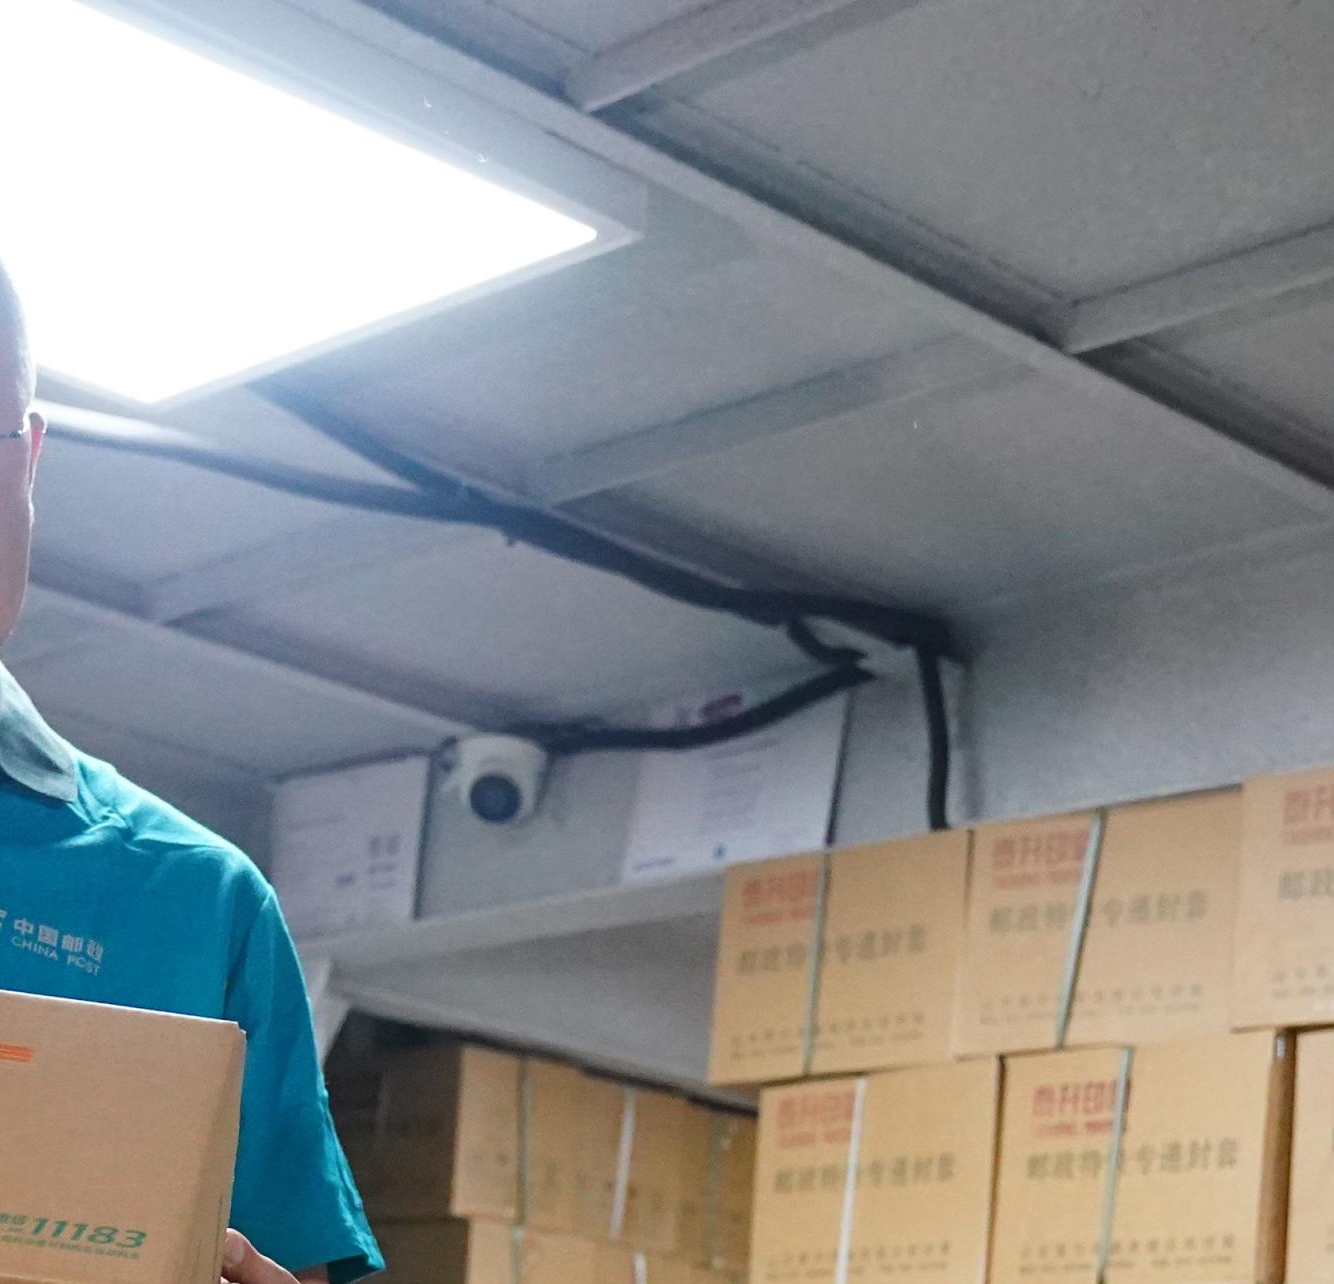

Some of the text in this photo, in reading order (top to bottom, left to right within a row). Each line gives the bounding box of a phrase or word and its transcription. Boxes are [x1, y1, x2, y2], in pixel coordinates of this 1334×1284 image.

[11, 936, 101, 976] CHINA POST
[13, 918, 104, 964] 中国邮政
[31, 1216, 148, 1249] 11183
